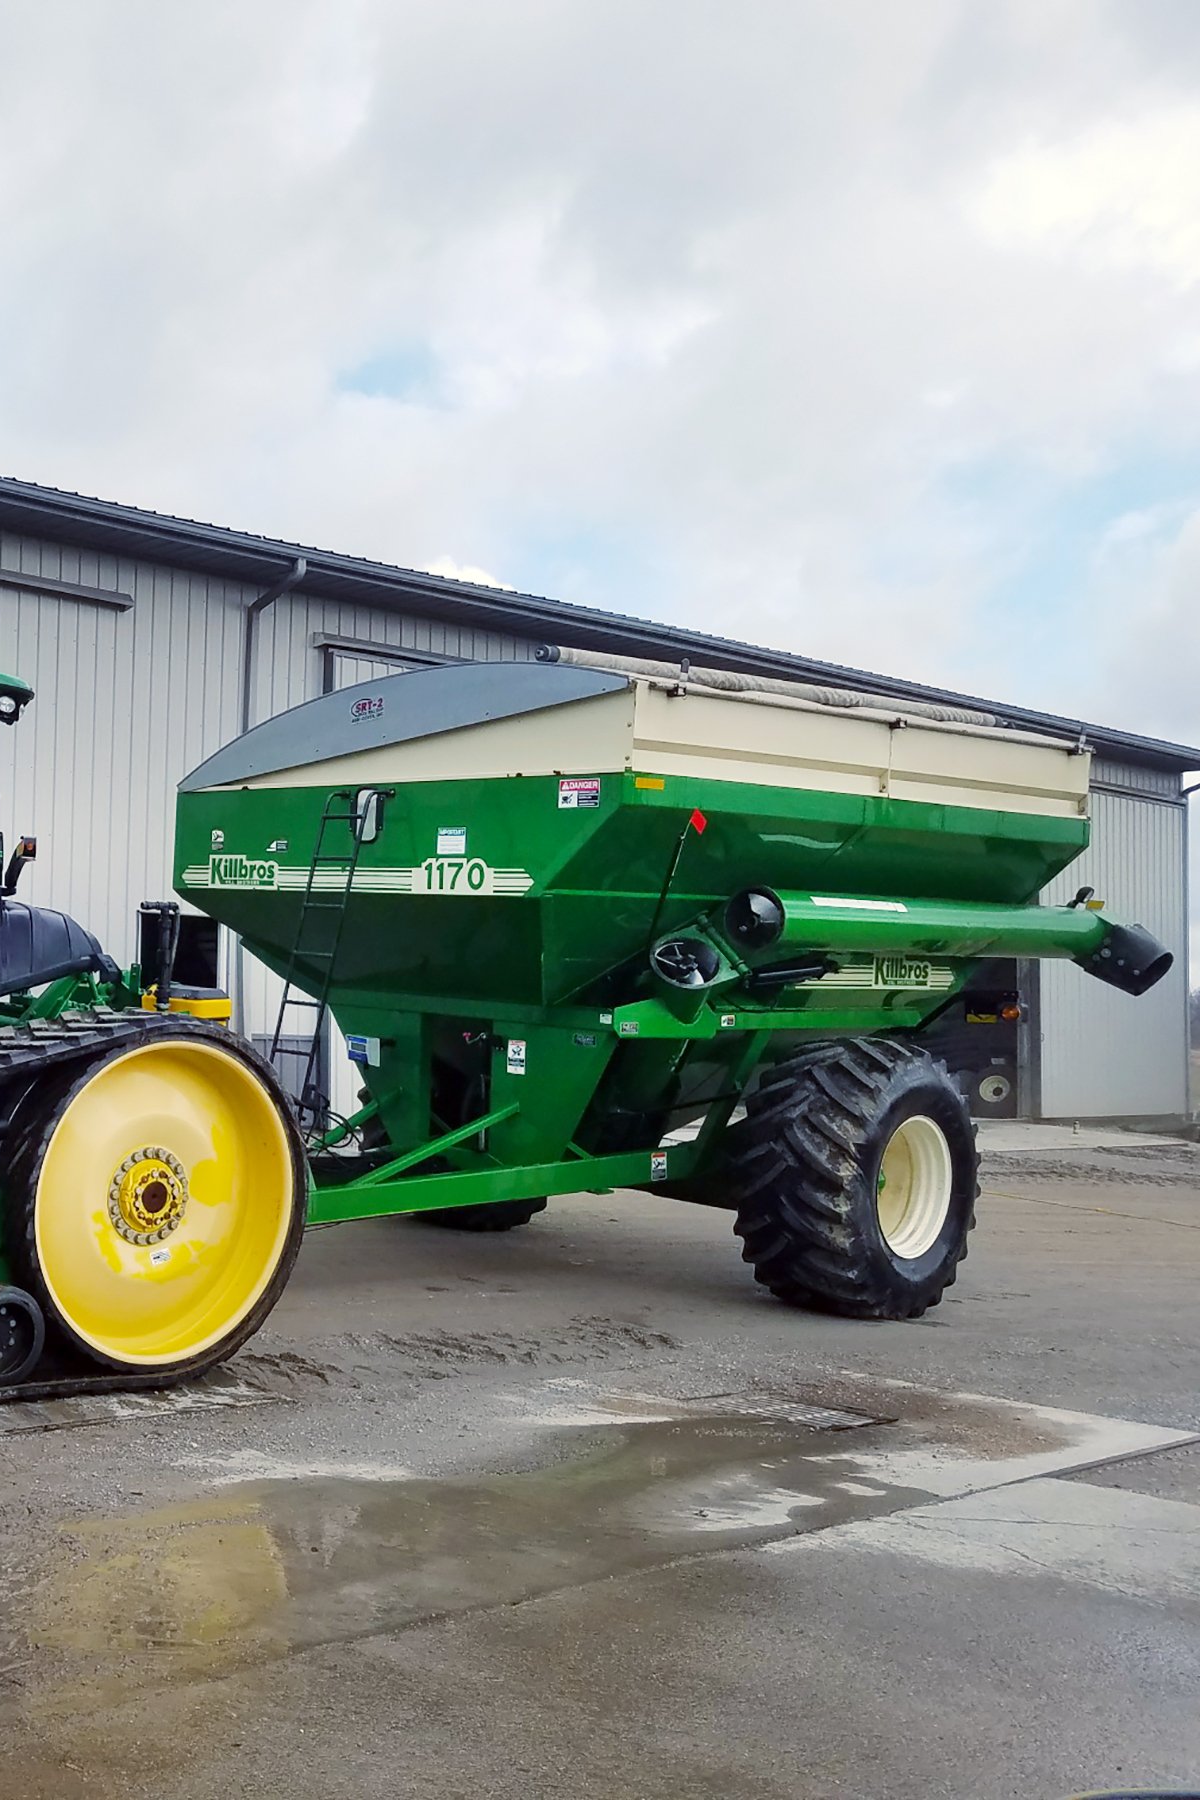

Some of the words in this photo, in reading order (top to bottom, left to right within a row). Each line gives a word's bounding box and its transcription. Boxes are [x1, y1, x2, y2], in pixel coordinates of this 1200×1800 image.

[355, 697, 384, 713] SRT-2
[570, 780, 598, 790] DANGER
[211, 857, 275, 885] Killbros
[424, 862, 485, 891] 1170
[874, 956, 929, 985] Killbros
